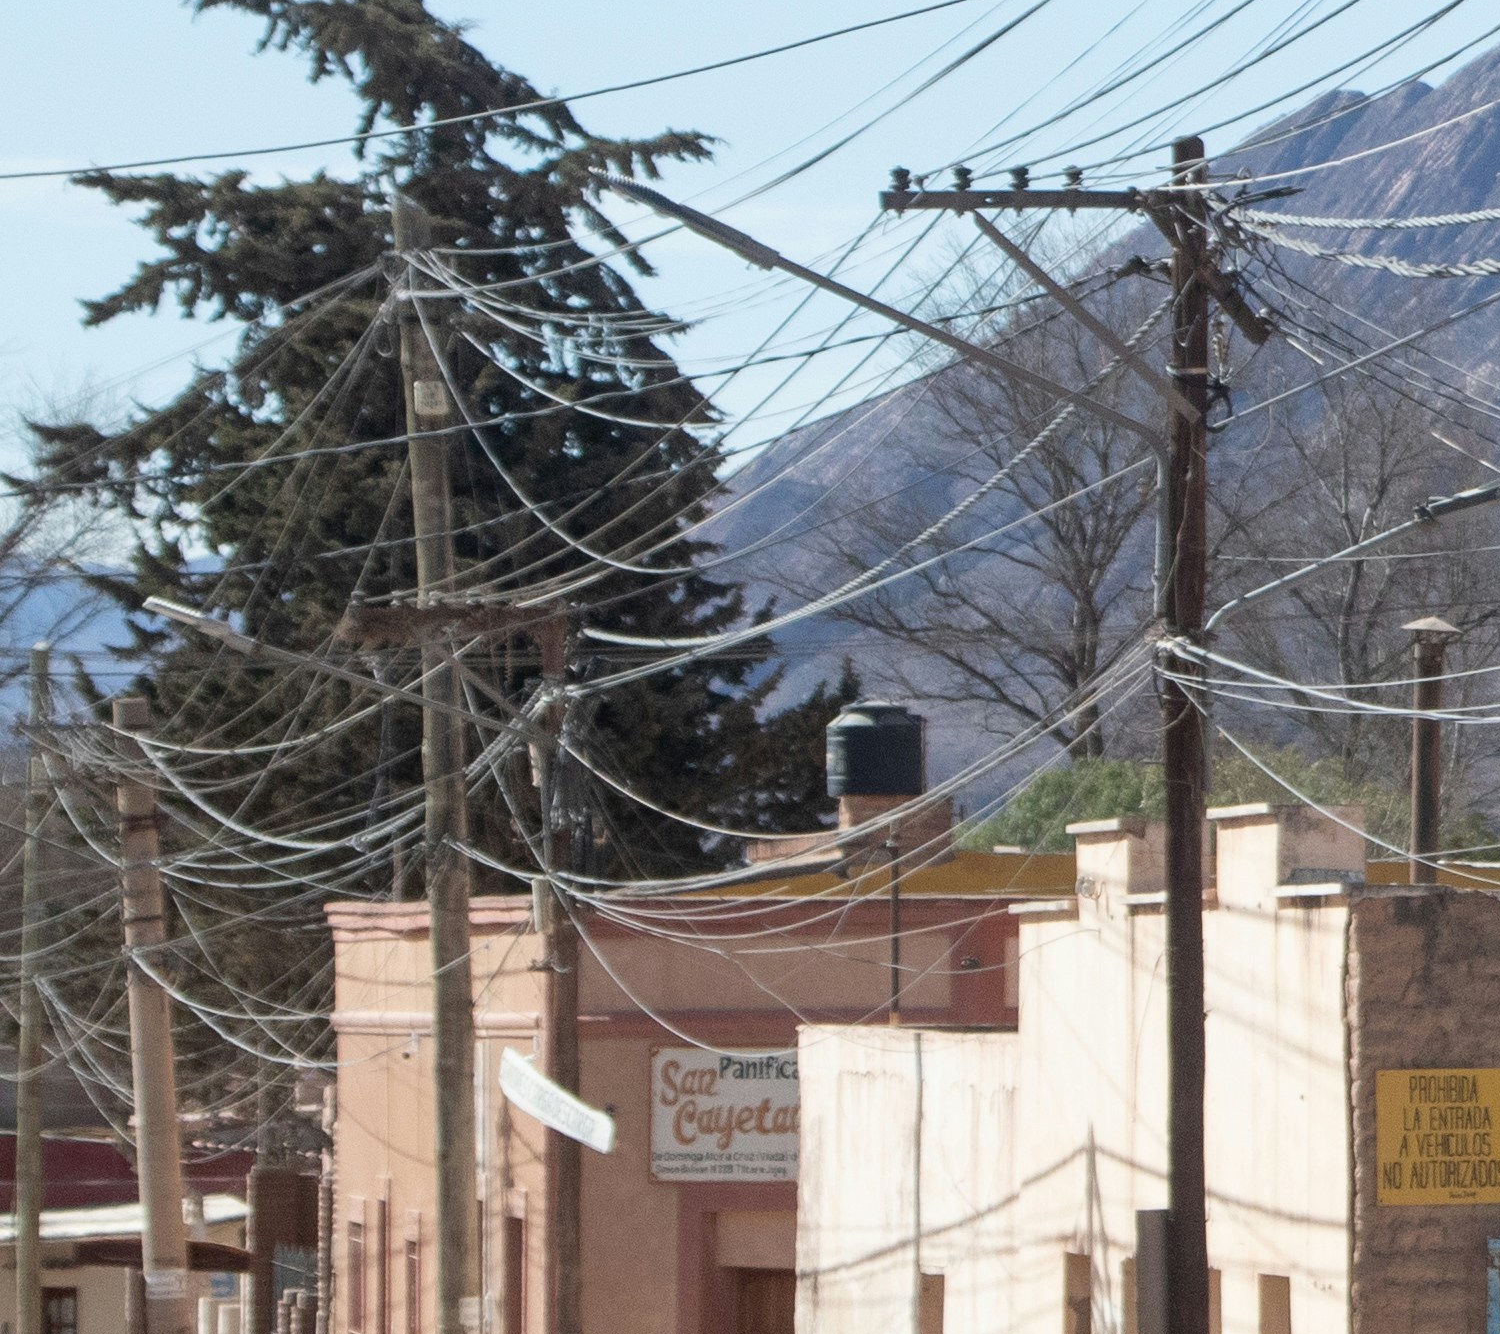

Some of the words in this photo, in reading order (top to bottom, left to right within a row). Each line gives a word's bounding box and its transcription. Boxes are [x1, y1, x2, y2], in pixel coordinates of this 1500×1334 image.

[659, 1059, 718, 1106] San
[1408, 1075, 1479, 1103] PROHIBIDA
[1402, 1107, 1421, 1131] LA
[1429, 1106, 1492, 1130] ENTRADA
[1399, 1133, 1409, 1158] A
[1416, 1132, 1491, 1157] VEHICULOS
[1382, 1161, 1402, 1190] NO
